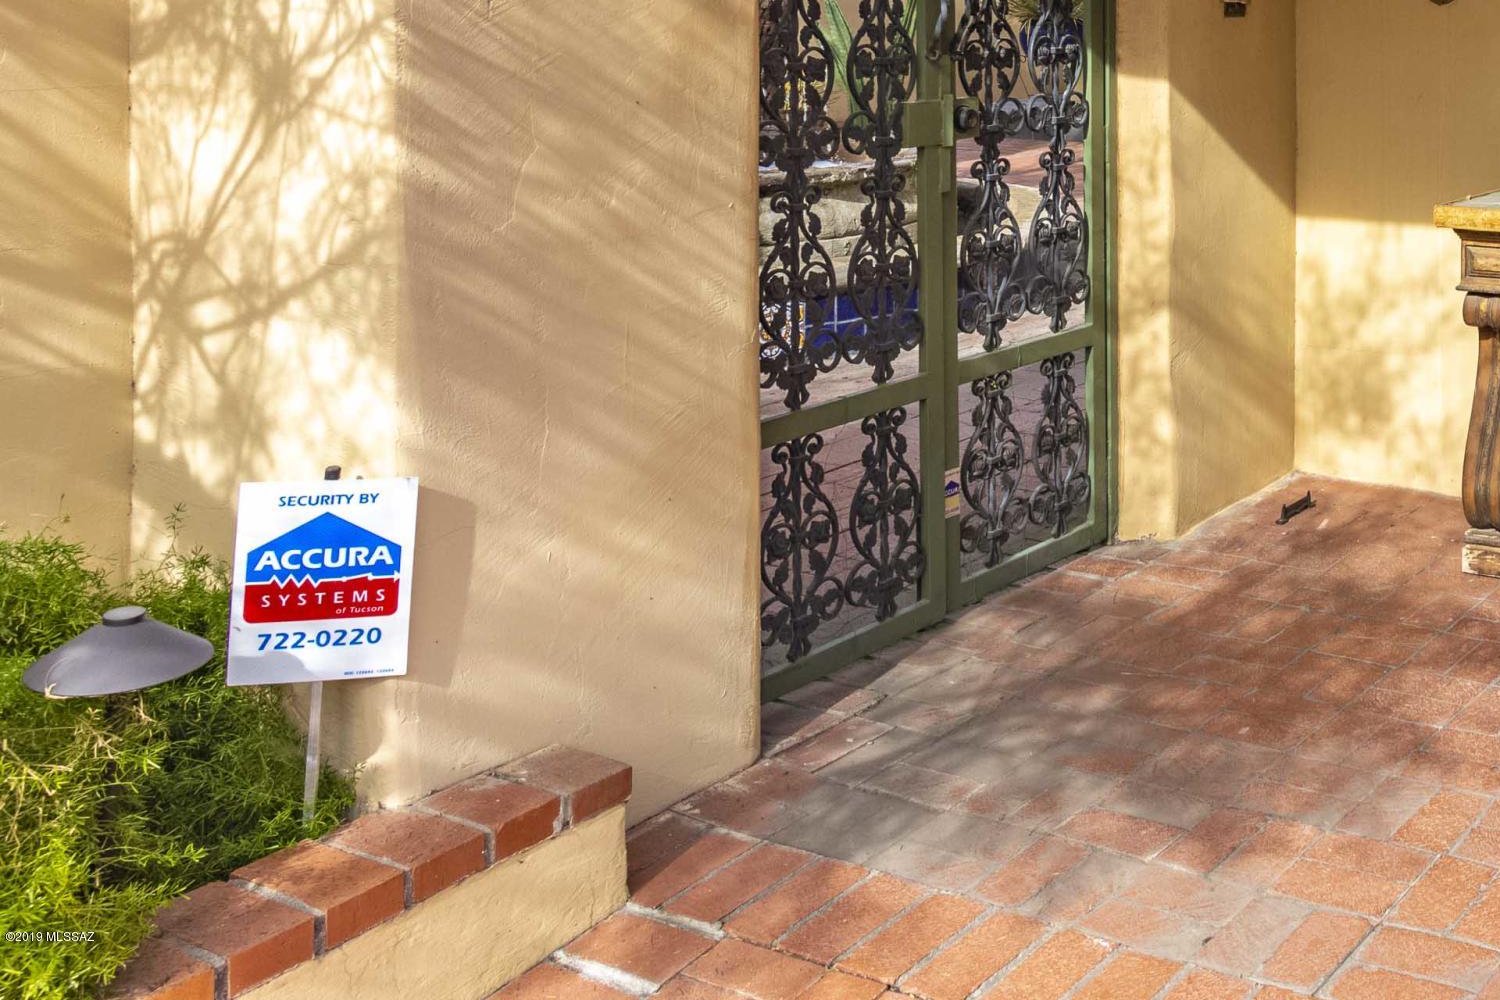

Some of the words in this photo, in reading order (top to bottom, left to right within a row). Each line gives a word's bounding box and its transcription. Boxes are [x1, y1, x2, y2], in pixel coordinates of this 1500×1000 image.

[278, 494, 354, 507] SECURITY
[359, 492, 380, 504] BY
[254, 545, 394, 572] ACCURA
[261, 588, 386, 608] SYSTEMS
[335, 606, 346, 615] of
[350, 605, 384, 614] Tucson
[257, 627, 382, 651] 722-0220
